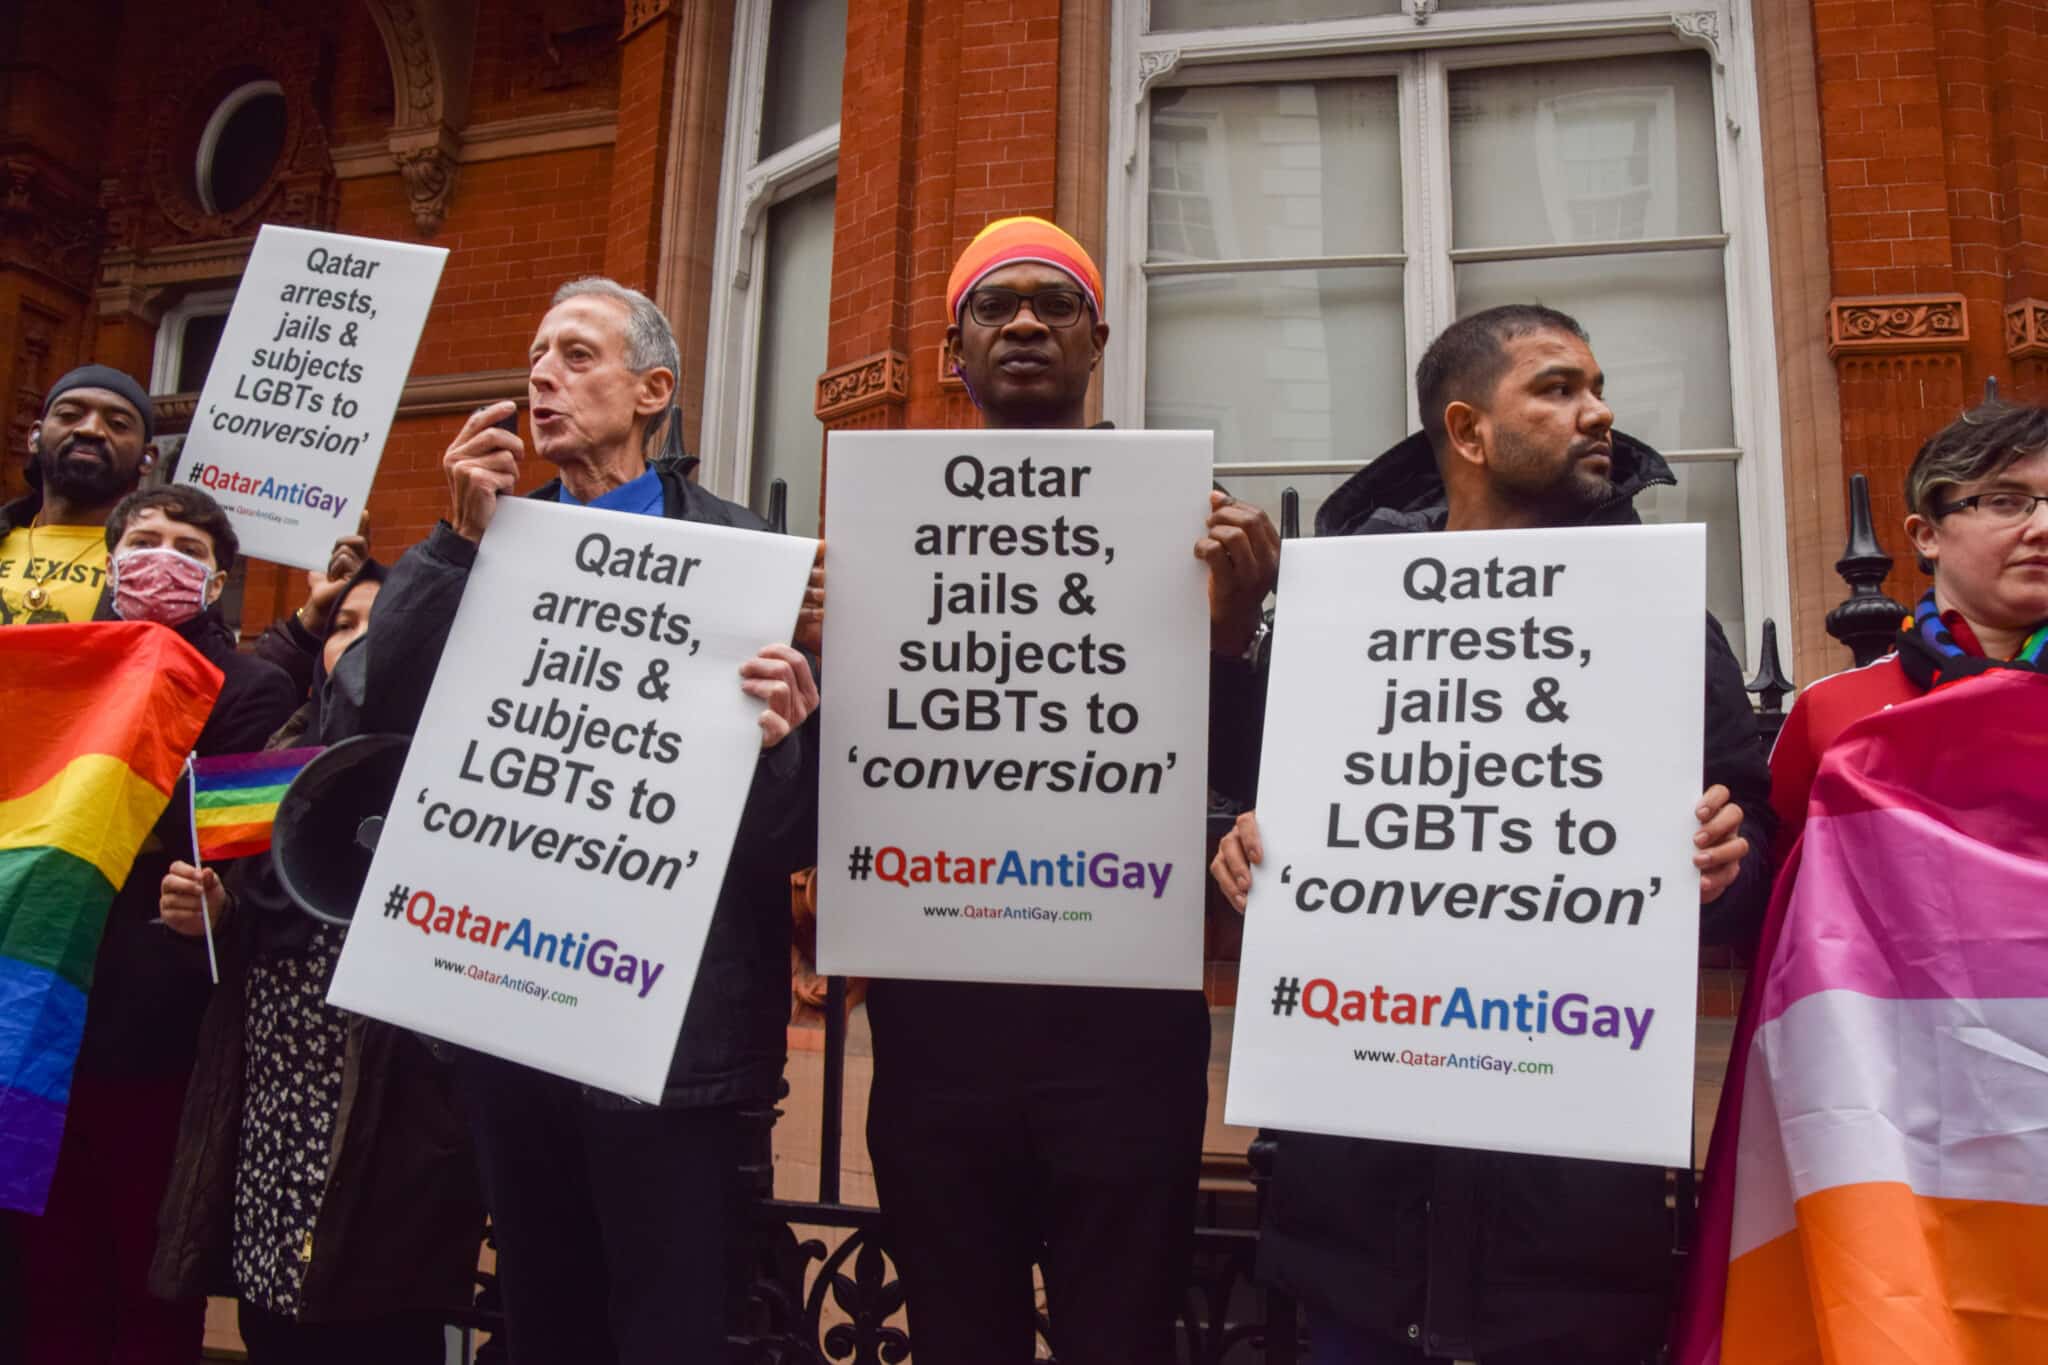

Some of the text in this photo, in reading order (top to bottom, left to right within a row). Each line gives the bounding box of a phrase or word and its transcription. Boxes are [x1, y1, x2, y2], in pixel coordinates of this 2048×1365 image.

[307, 247, 381, 280] Qatar
[280, 284, 376, 320] arrests,
[272, 312, 358, 348] jails &
[251, 347, 363, 384] subjects
[234, 374, 358, 419] LGBTs to
[188, 462, 348, 519] #QatarAntiGay
[944, 455, 1092, 501] Qatar
[575, 532, 702, 587] Qatar
[914, 515, 1114, 565] arrests,
[0, 558, 106, 588] E EXIST
[927, 572, 1096, 626] jails &
[1403, 556, 1567, 604] Qatar
[532, 592, 701, 656] arrests,
[1367, 616, 1591, 668] arrests,
[521, 637, 671, 703] jails &
[899, 630, 1126, 685] subjects
[487, 697, 682, 764] subjects
[888, 688, 1139, 735] LGBTs to
[1377, 676, 1570, 736] jails &
[458, 739, 676, 825] LGBTs to
[1344, 740, 1603, 800] subjects
[1327, 802, 1617, 856] LGBTs to
[848, 845, 1173, 899] #QatarAntiGay
[923, 904, 1092, 923] www.QatarAntiGay.com
[384, 884, 665, 1000] #QatarAntiGay
[434, 957, 578, 1007] www.QatarAntiGay.com
[1271, 976, 1655, 1051] #QatarAntiGay
[1354, 1048, 1553, 1075] www.QatarAntiGay.com
